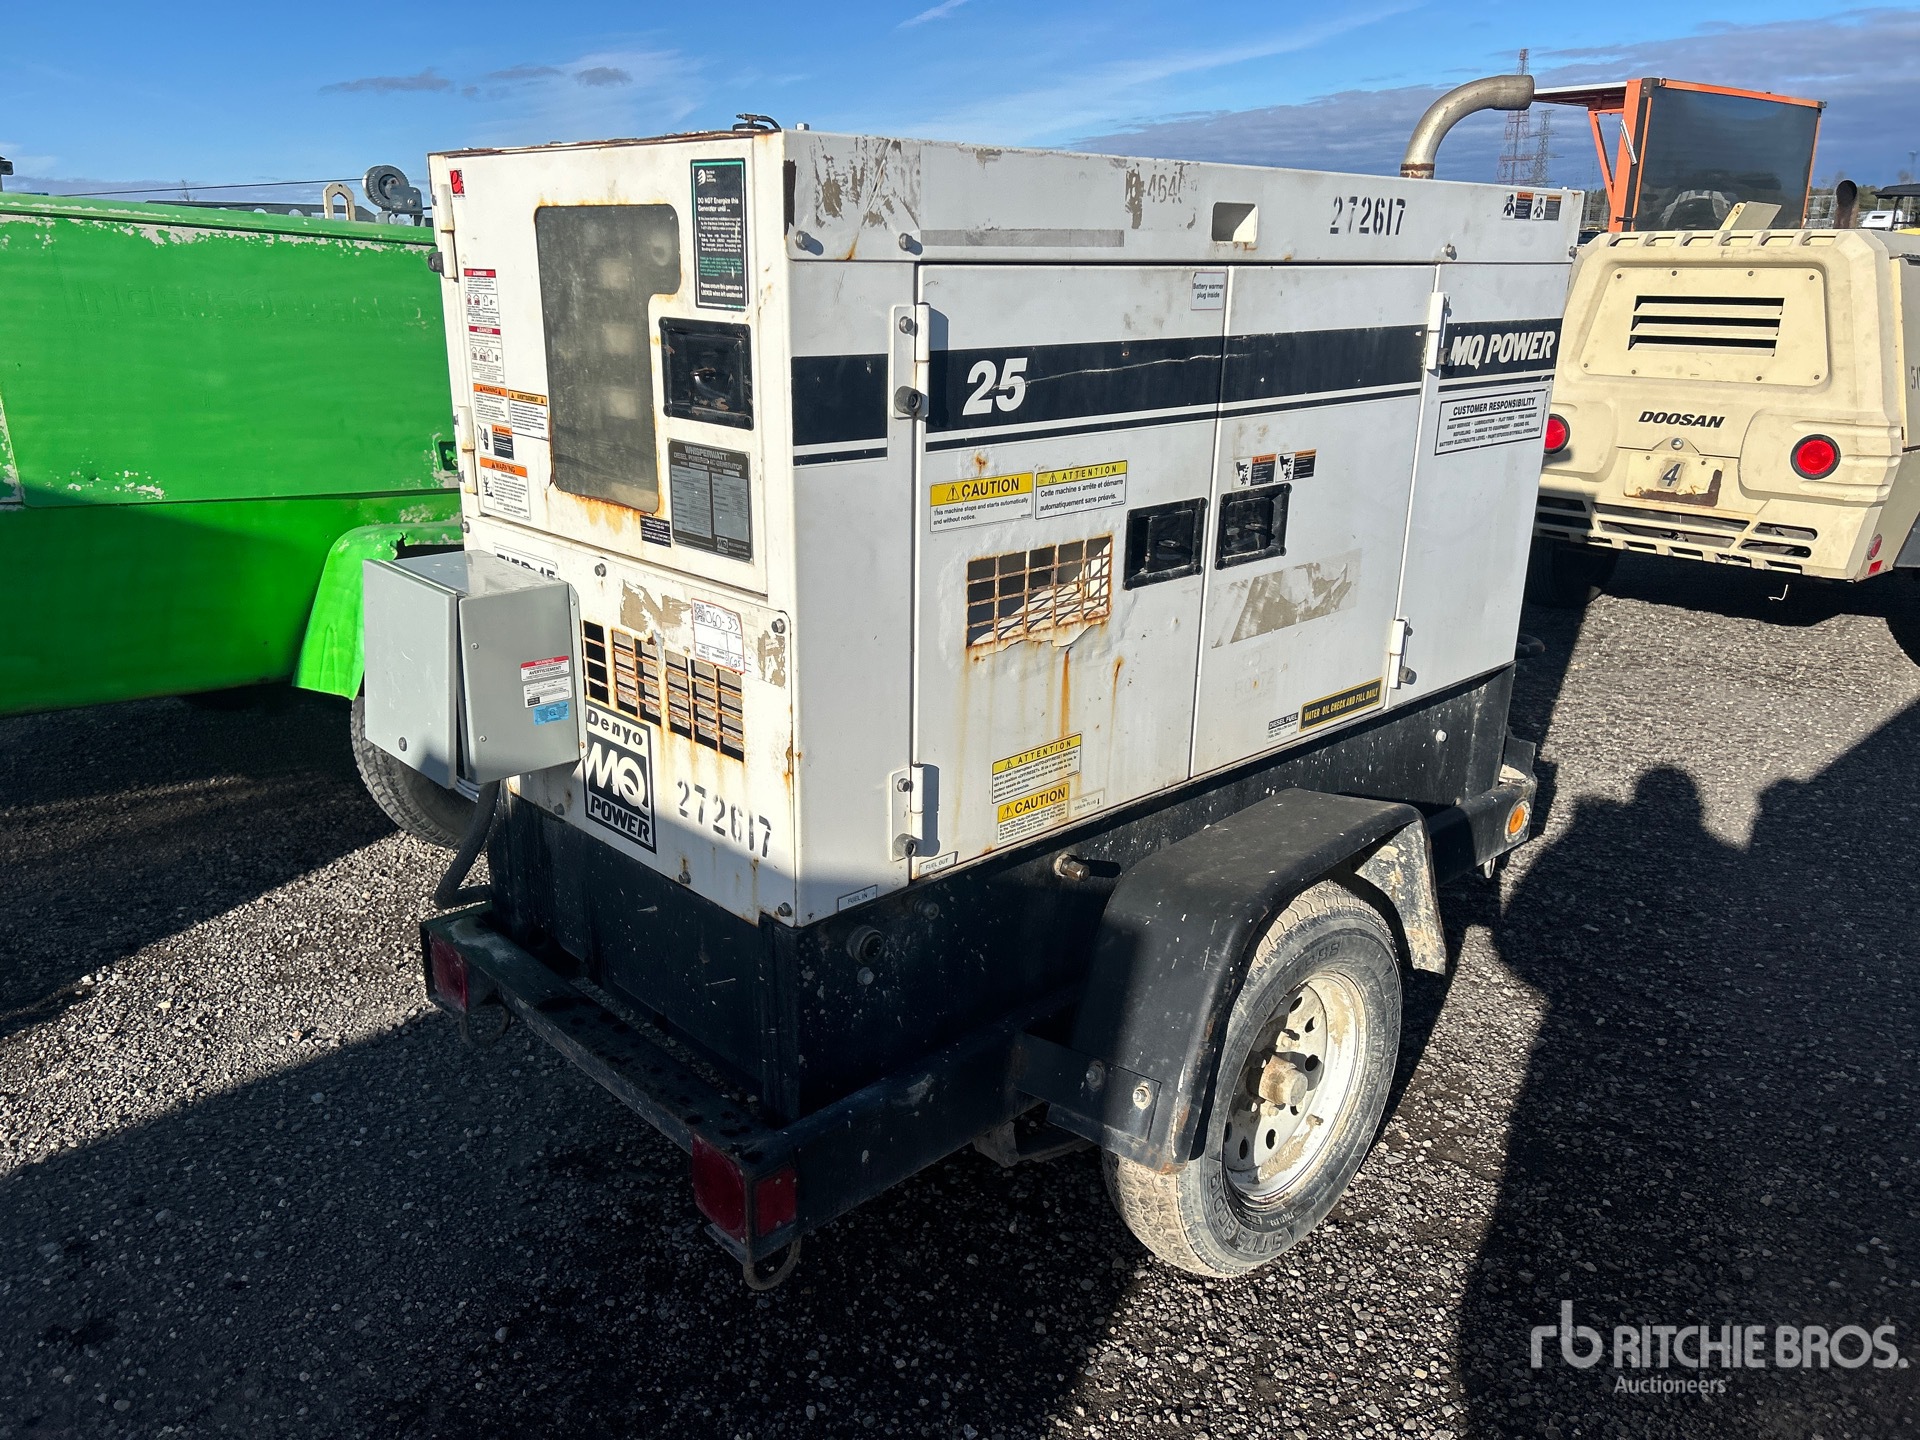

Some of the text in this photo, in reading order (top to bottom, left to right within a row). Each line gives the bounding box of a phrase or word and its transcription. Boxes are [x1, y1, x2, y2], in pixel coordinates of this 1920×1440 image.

[1330, 196, 1406, 235] 272617
[1451, 331, 1556, 370] MQ POWER
[962, 358, 1027, 416] 25
[1453, 397, 1536, 416] CUSTOMER RESPONSIBILITY
[1638, 411, 1725, 428] DOOSAN
[1062, 465, 1116, 481] ATTENTION
[1662, 464, 1681, 486] 4
[962, 478, 1020, 501] CAUTION
[1040, 489, 1054, 498] Cette
[1055, 486, 1076, 496] machine
[1103, 479, 1123, 488] démarre
[934, 507, 943, 516] This
[944, 505, 963, 514] machine
[964, 504, 976, 513] stops
[987, 501, 999, 509] starts
[1000, 497, 1028, 507] automatically
[1040, 498, 1084, 512] automatiquement
[1085, 496, 1097, 504] sans
[1097, 493, 1116, 503] préavis.
[943, 515, 960, 524] without
[961, 514, 976, 522] notice.
[1304, 687, 1379, 721] WATER OIL CHECK AND FILL DAILY
[587, 708, 643, 745] Denyo
[1018, 740, 1071, 764] ATTENTION
[586, 742, 650, 818] MQ
[1015, 787, 1065, 813] CAUTION
[590, 795, 650, 841] POWER
[677, 780, 772, 858] 272617
[939, 858, 949, 866] OUT
[848, 896, 861, 904] FUEL
